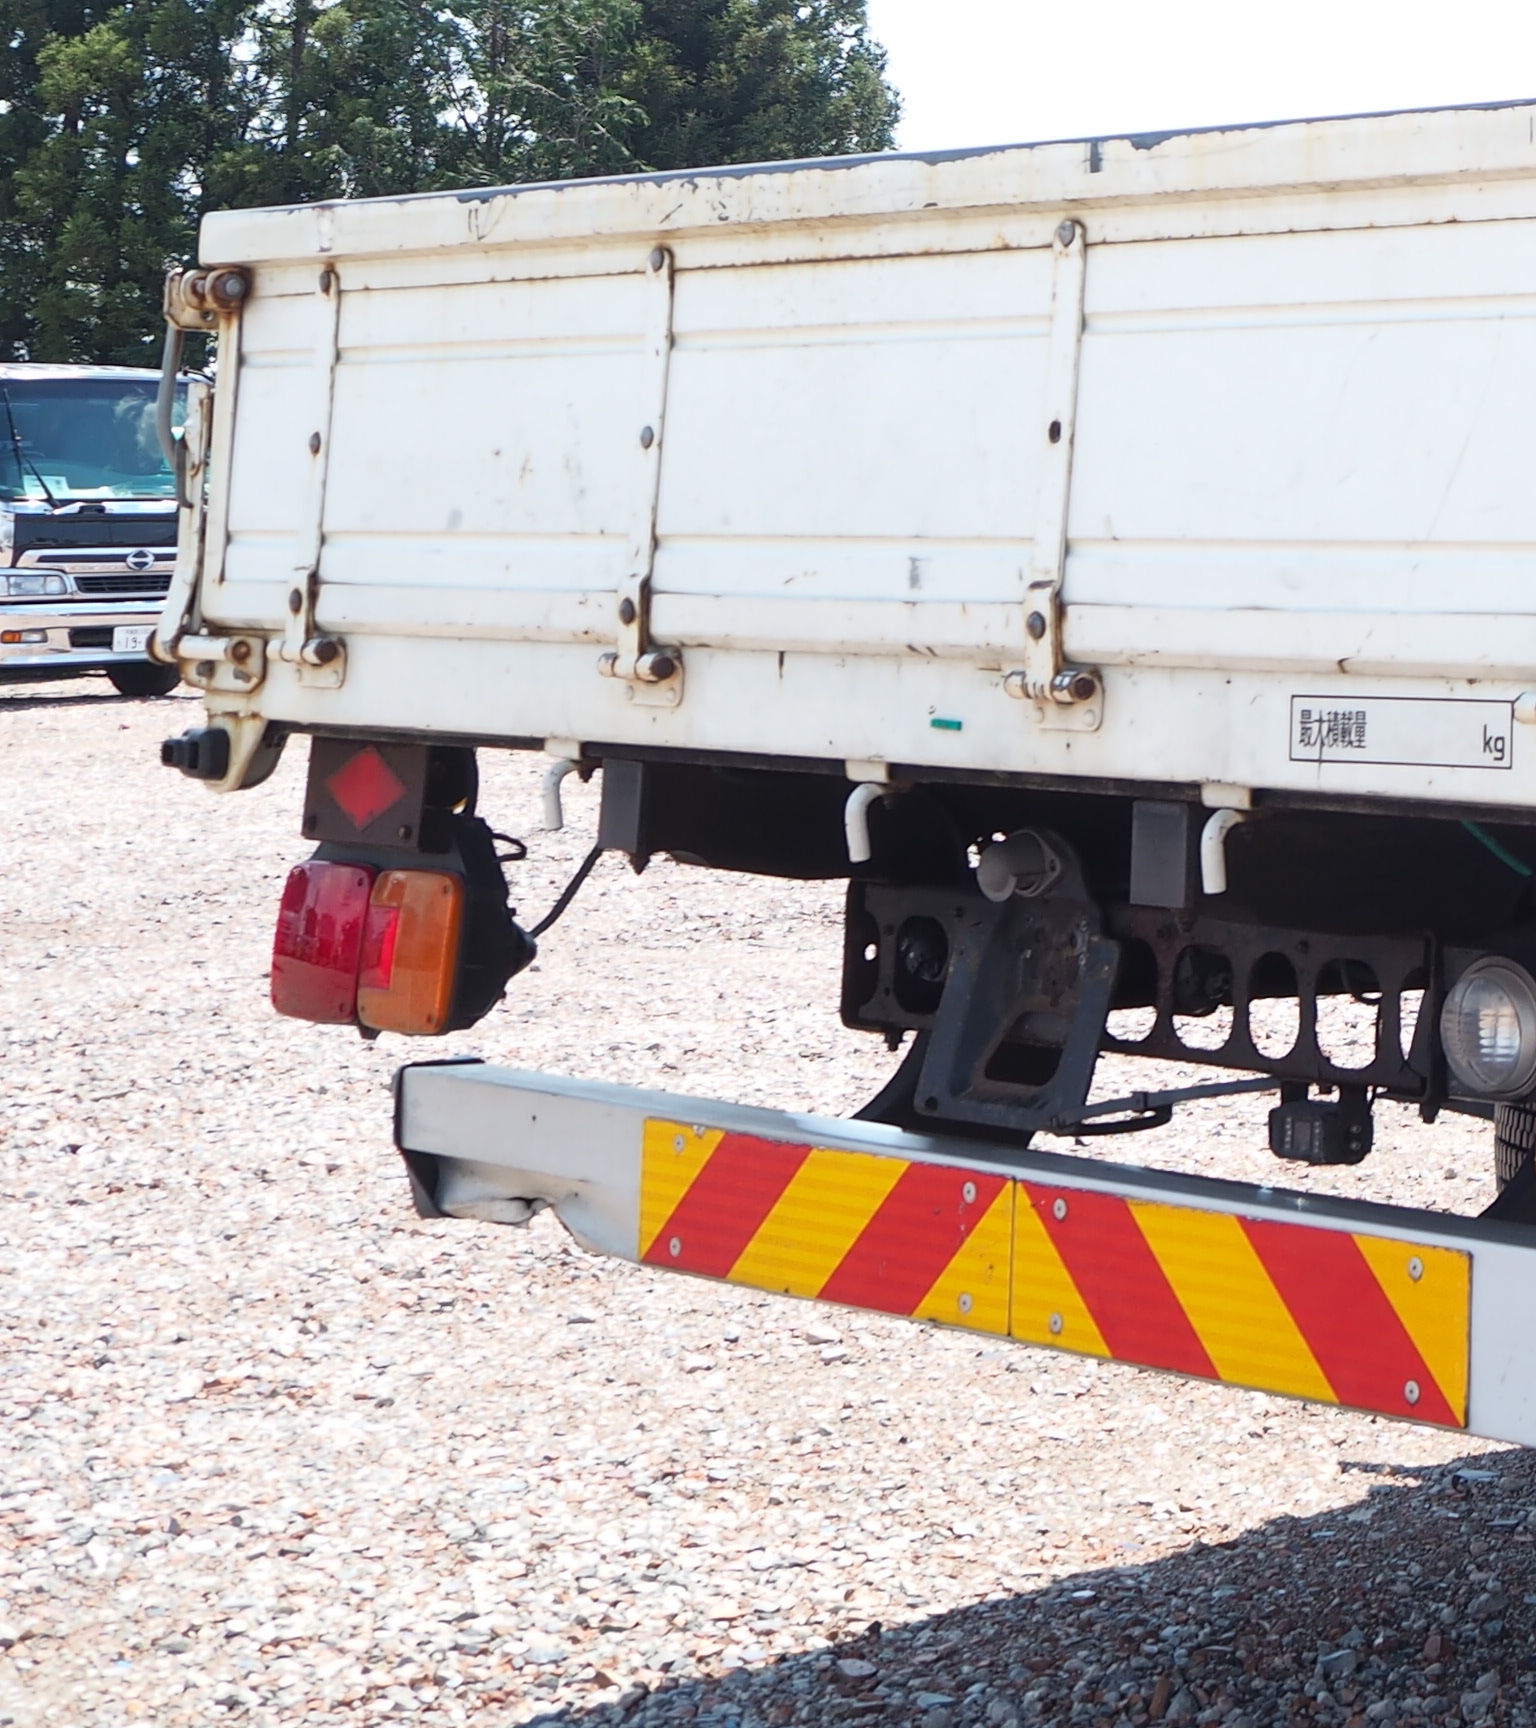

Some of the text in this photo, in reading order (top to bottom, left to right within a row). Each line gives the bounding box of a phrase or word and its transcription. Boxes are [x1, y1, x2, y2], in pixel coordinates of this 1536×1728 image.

[1298, 709, 1367, 750] 最大積載量
[1483, 724, 1506, 761] kg
